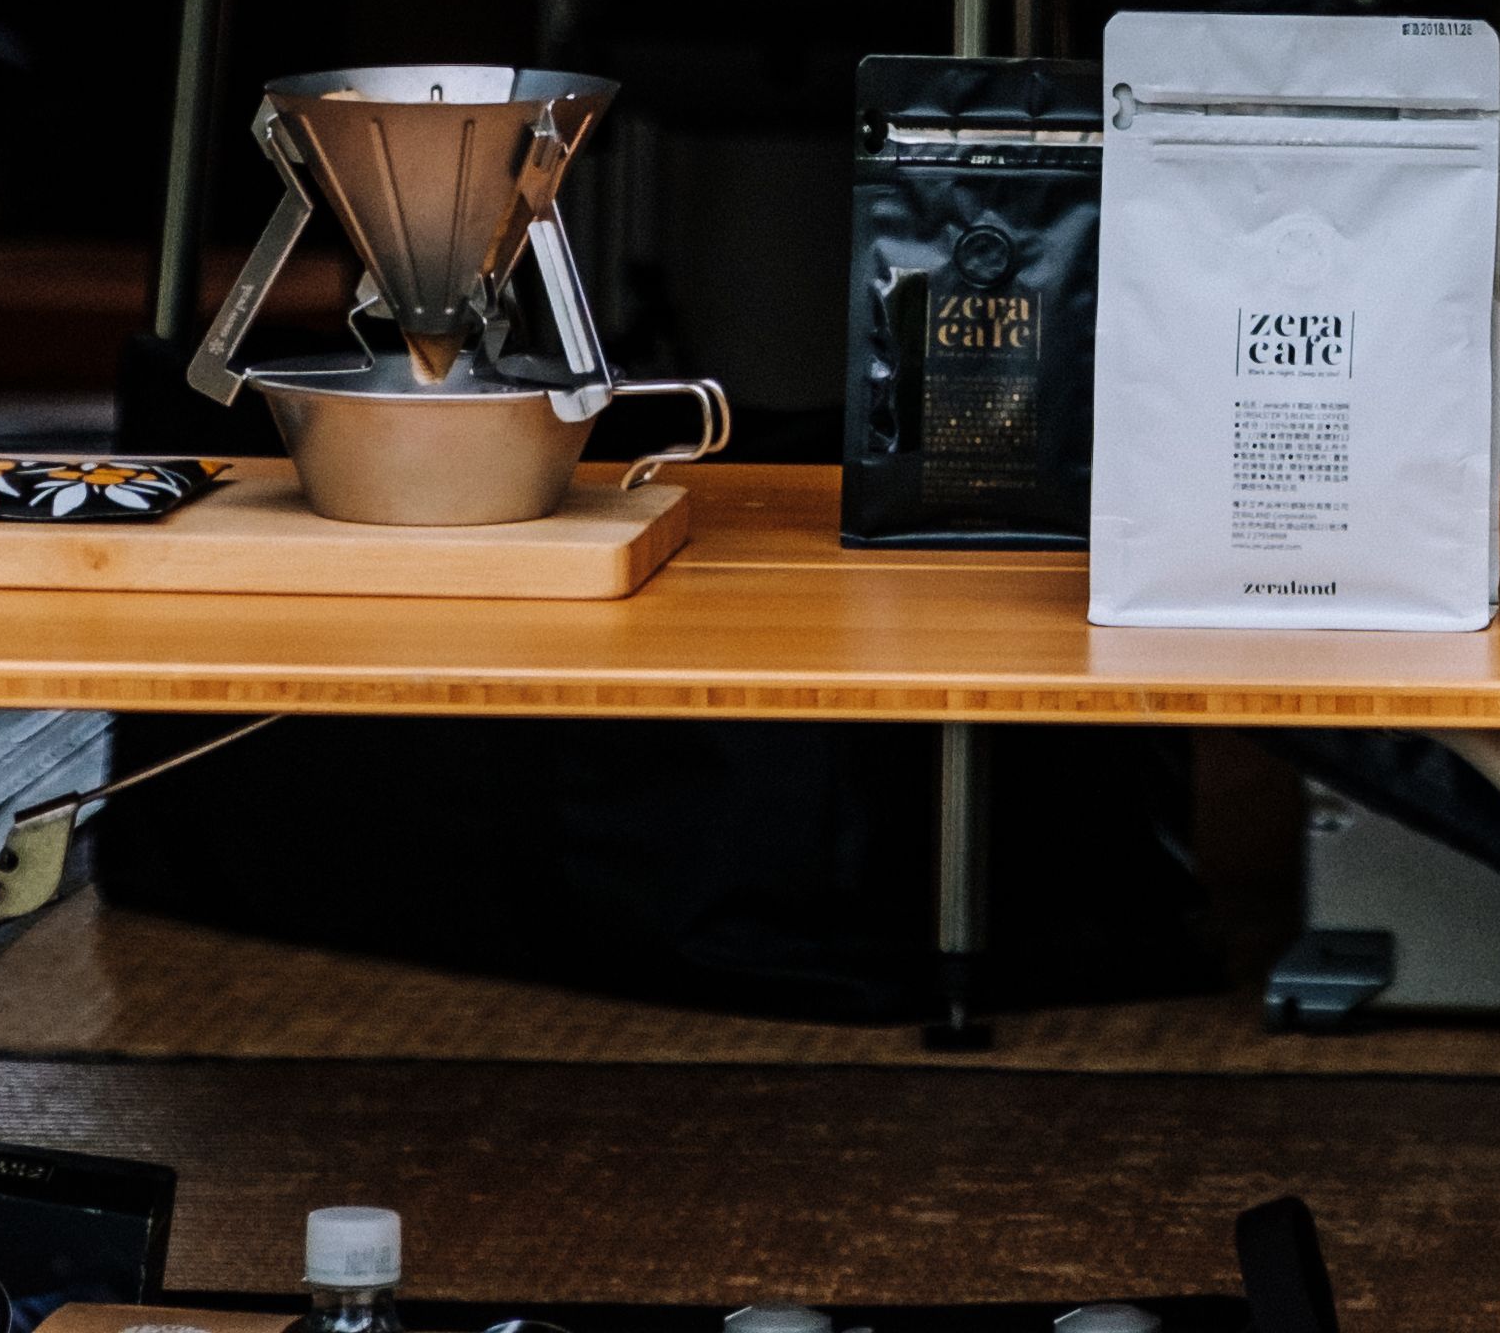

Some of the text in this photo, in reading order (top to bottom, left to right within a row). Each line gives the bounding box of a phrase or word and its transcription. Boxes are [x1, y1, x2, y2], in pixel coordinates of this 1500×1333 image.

[938, 296, 1029, 321] zera
[938, 318, 1030, 347] cafe
[1250, 314, 1342, 338] zera
[1249, 335, 1342, 365] cafe
[1244, 581, 1336, 595] zeraland
